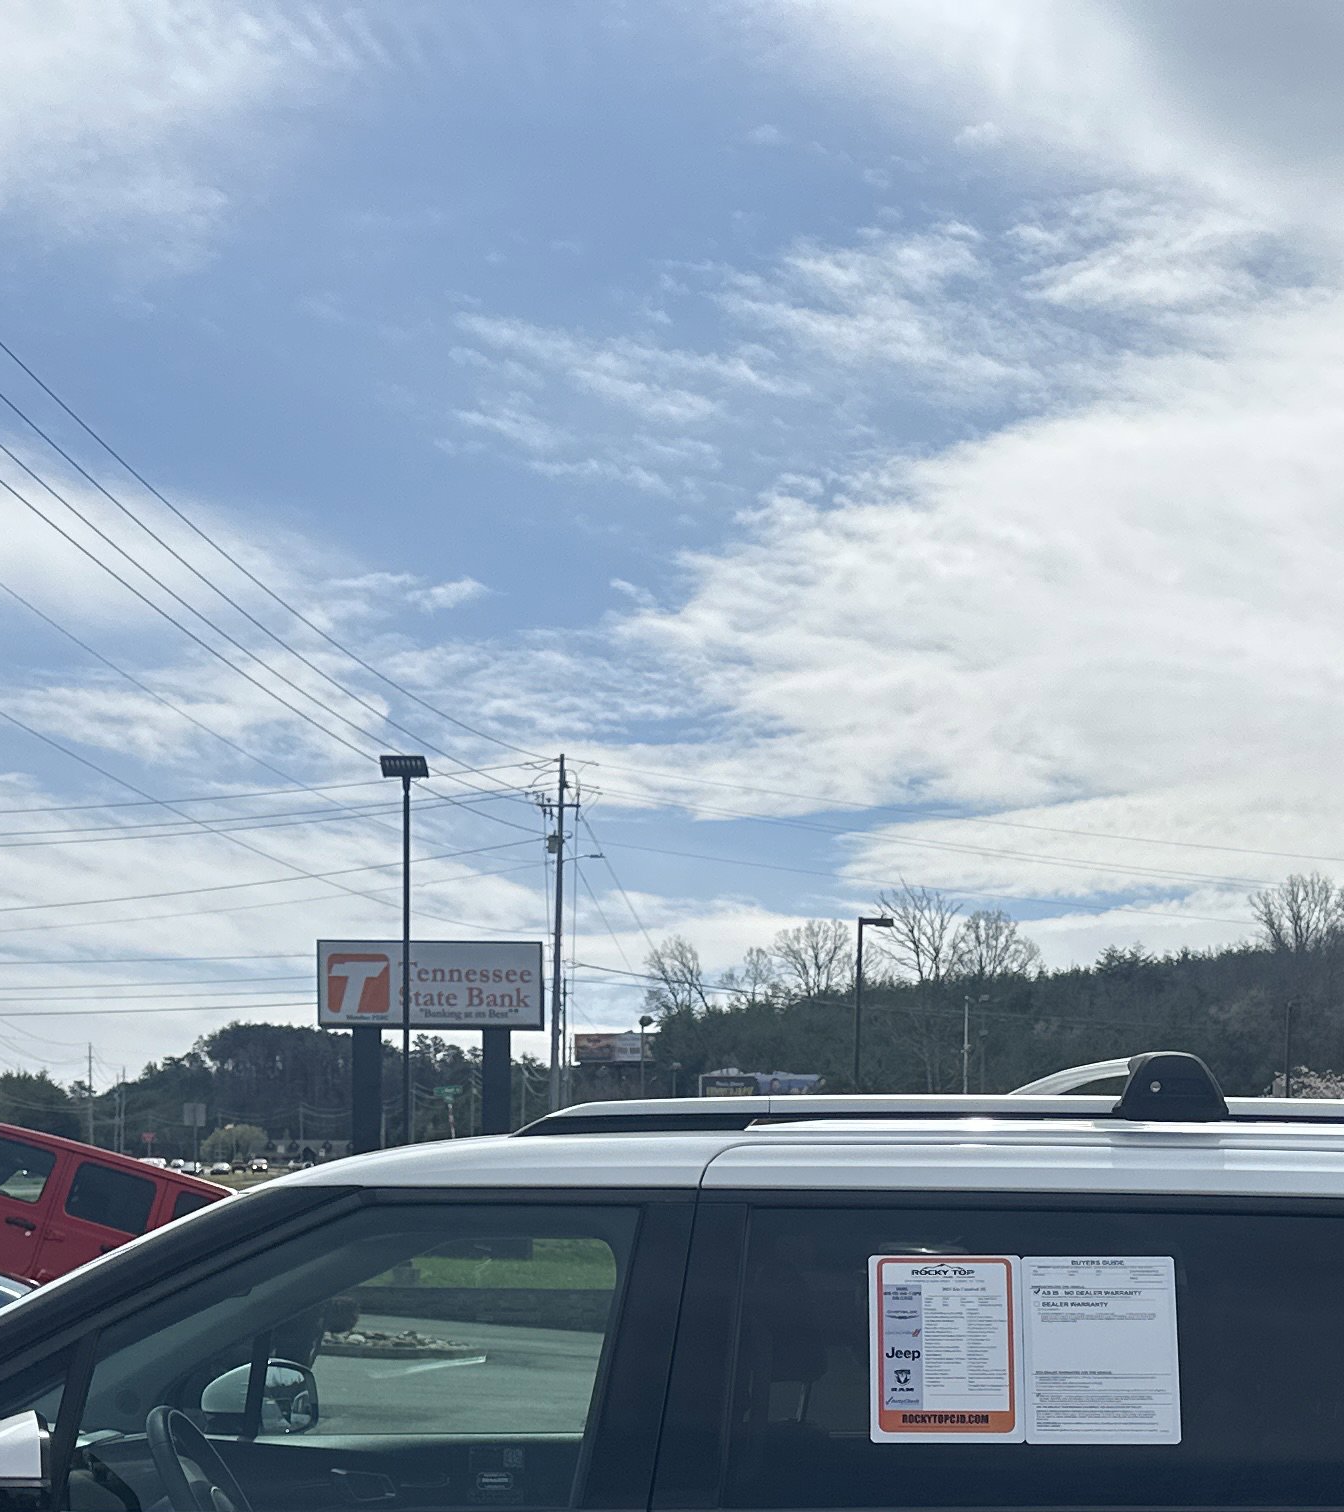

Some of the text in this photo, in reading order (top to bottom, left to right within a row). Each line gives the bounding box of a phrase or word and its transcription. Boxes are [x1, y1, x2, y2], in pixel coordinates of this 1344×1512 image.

[398, 961, 532, 984] Tennessee
[399, 986, 531, 1008] State Bank
[885, 1346, 921, 1361] Jeep
[901, 1414, 989, 1424] ROCKYTOPCJD.COM
